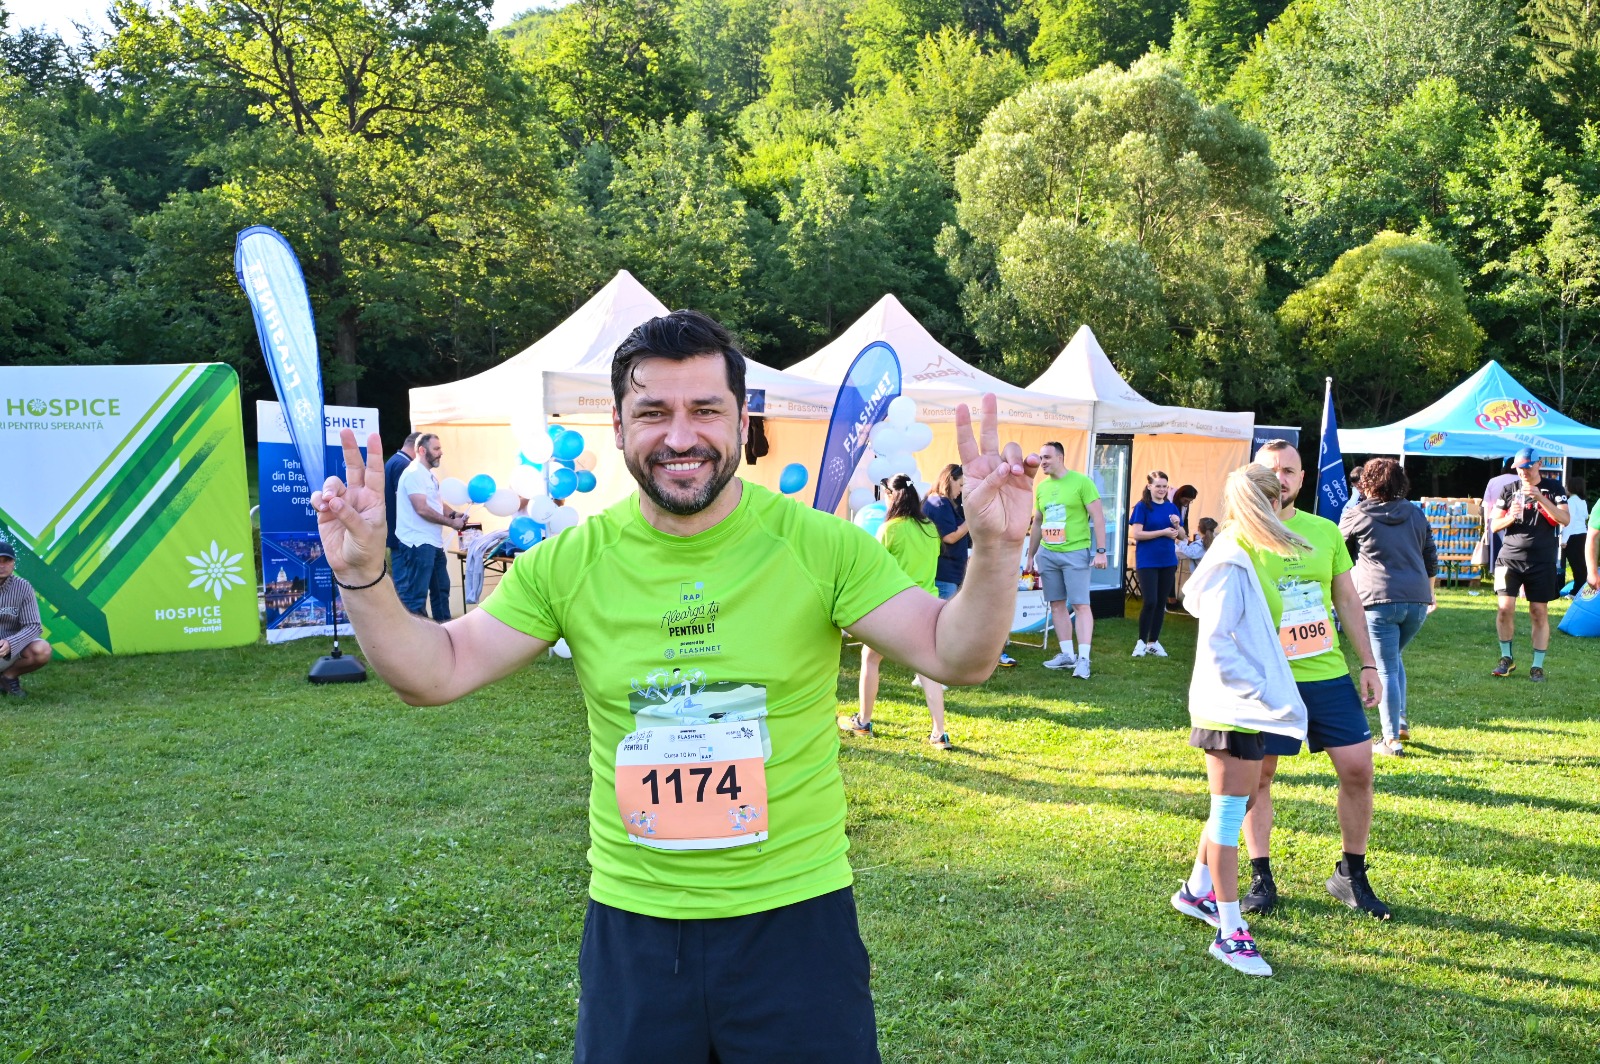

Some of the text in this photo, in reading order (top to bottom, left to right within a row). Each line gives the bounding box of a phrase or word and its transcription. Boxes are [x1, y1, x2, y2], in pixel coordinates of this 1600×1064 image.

[6, 398, 121, 417] HOSPICE
[578, 396, 612, 408] Brașov
[787, 402, 829, 413] Brassovia
[843, 371, 892, 453] FLASHNET
[922, 407, 956, 416] Kronstad
[1008, 409, 1033, 418] Corona
[1044, 411, 1075, 422] Brassovia
[1474, 398, 1549, 431] Cooler
[8, 421, 49, 430] PENTRU
[50, 420, 104, 432] SPERANȚĂ
[324, 416, 366, 429] SHNET
[1534, 439, 1565, 452] ALCOOL
[271, 471, 286, 481] din
[271, 483, 291, 493] cele
[291, 496, 312, 507] oraș
[1322, 484, 1339, 507] group
[1045, 528, 1061, 536] 1127
[683, 593, 701, 601] RAP
[155, 605, 222, 621] HOSPICE
[202, 617, 222, 625] Casa
[668, 622, 716, 637] PENTRU EI
[1288, 621, 1327, 642] 1096
[679, 645, 721, 654] FLASHNET
[623, 743, 643, 751] PENTRU
[642, 765, 741, 804] 1174
